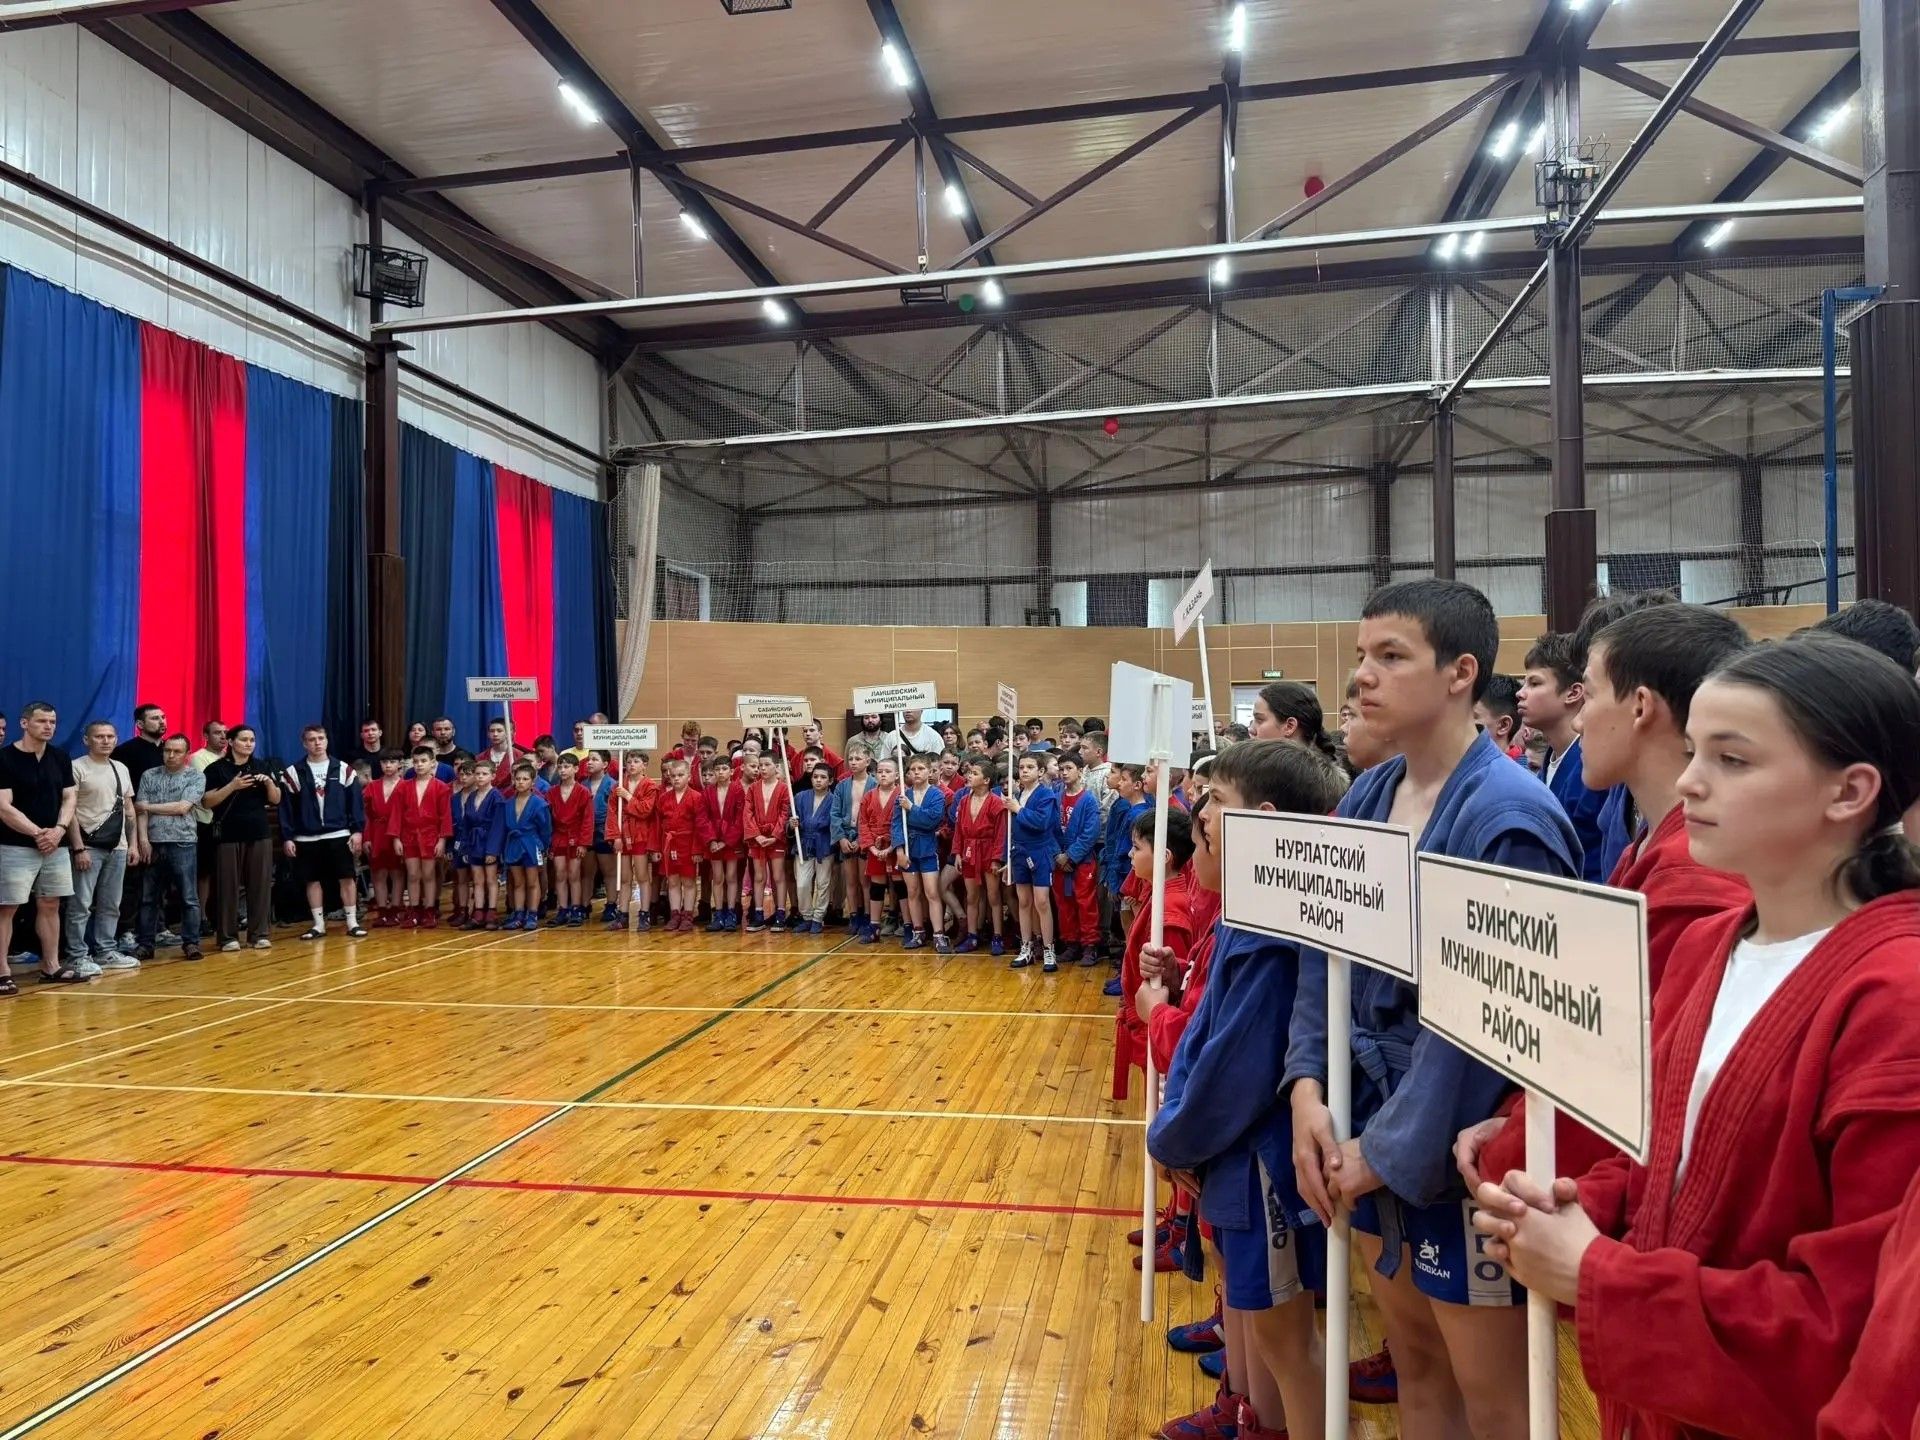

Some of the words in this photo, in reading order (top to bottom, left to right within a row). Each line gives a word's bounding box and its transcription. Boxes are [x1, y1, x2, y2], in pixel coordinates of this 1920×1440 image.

[864, 694, 925, 705] МУНИЦИПАЛЬНЫЙ
[871, 686, 918, 697] ЛАИШЕВСКИЙ
[884, 702, 907, 711] РАЙОН
[1275, 838, 1365, 873] НУРЛАТСКИЙ
[1254, 864, 1384, 912] МУНИЦИПАЛЬНЫЙ
[1300, 901, 1344, 934] РАЙОН
[1467, 899, 1558, 960] БУИНСКИЙ
[1441, 936, 1602, 1036] МУНИЦИПАЛЬНЫЙ
[1482, 1001, 1540, 1064] РАЙОН
